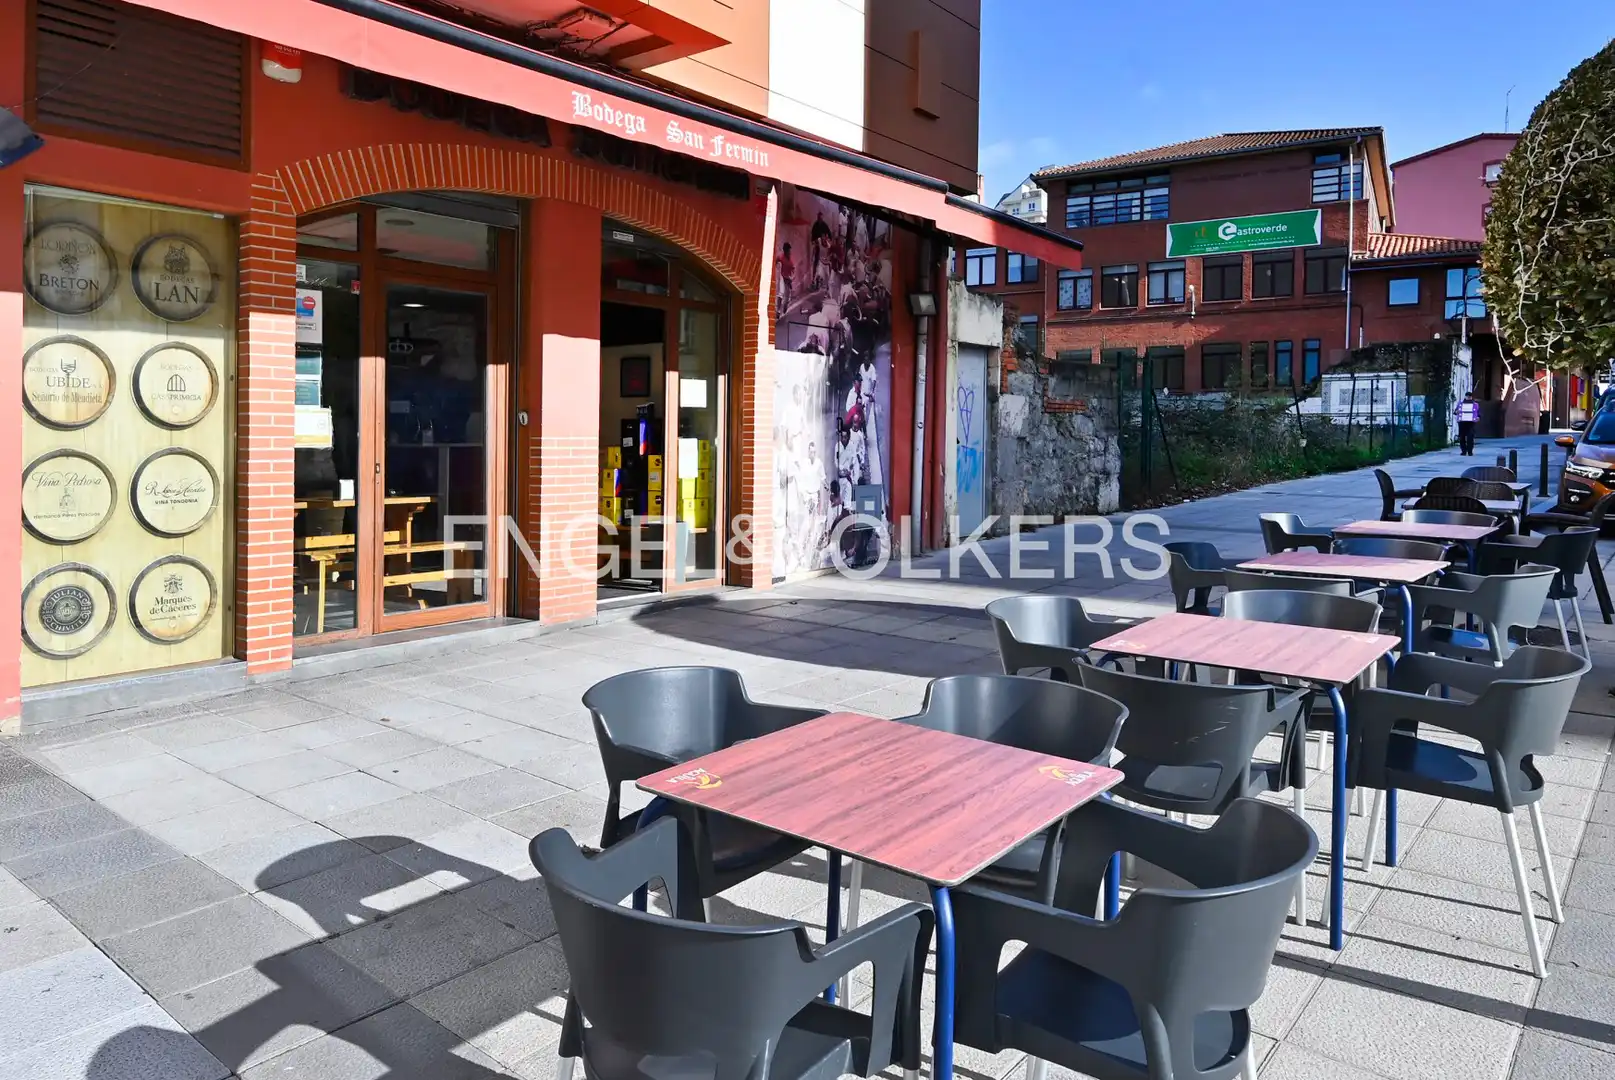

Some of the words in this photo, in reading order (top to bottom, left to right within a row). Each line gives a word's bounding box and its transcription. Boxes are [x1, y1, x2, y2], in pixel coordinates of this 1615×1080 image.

[571, 90, 646, 135] Bodega
[666, 120, 704, 150] San
[709, 134, 769, 167] Fermin
[154, 281, 200, 305] LAN
[46, 374, 92, 389] UBIDE
[51, 589, 84, 602] JULIAN
